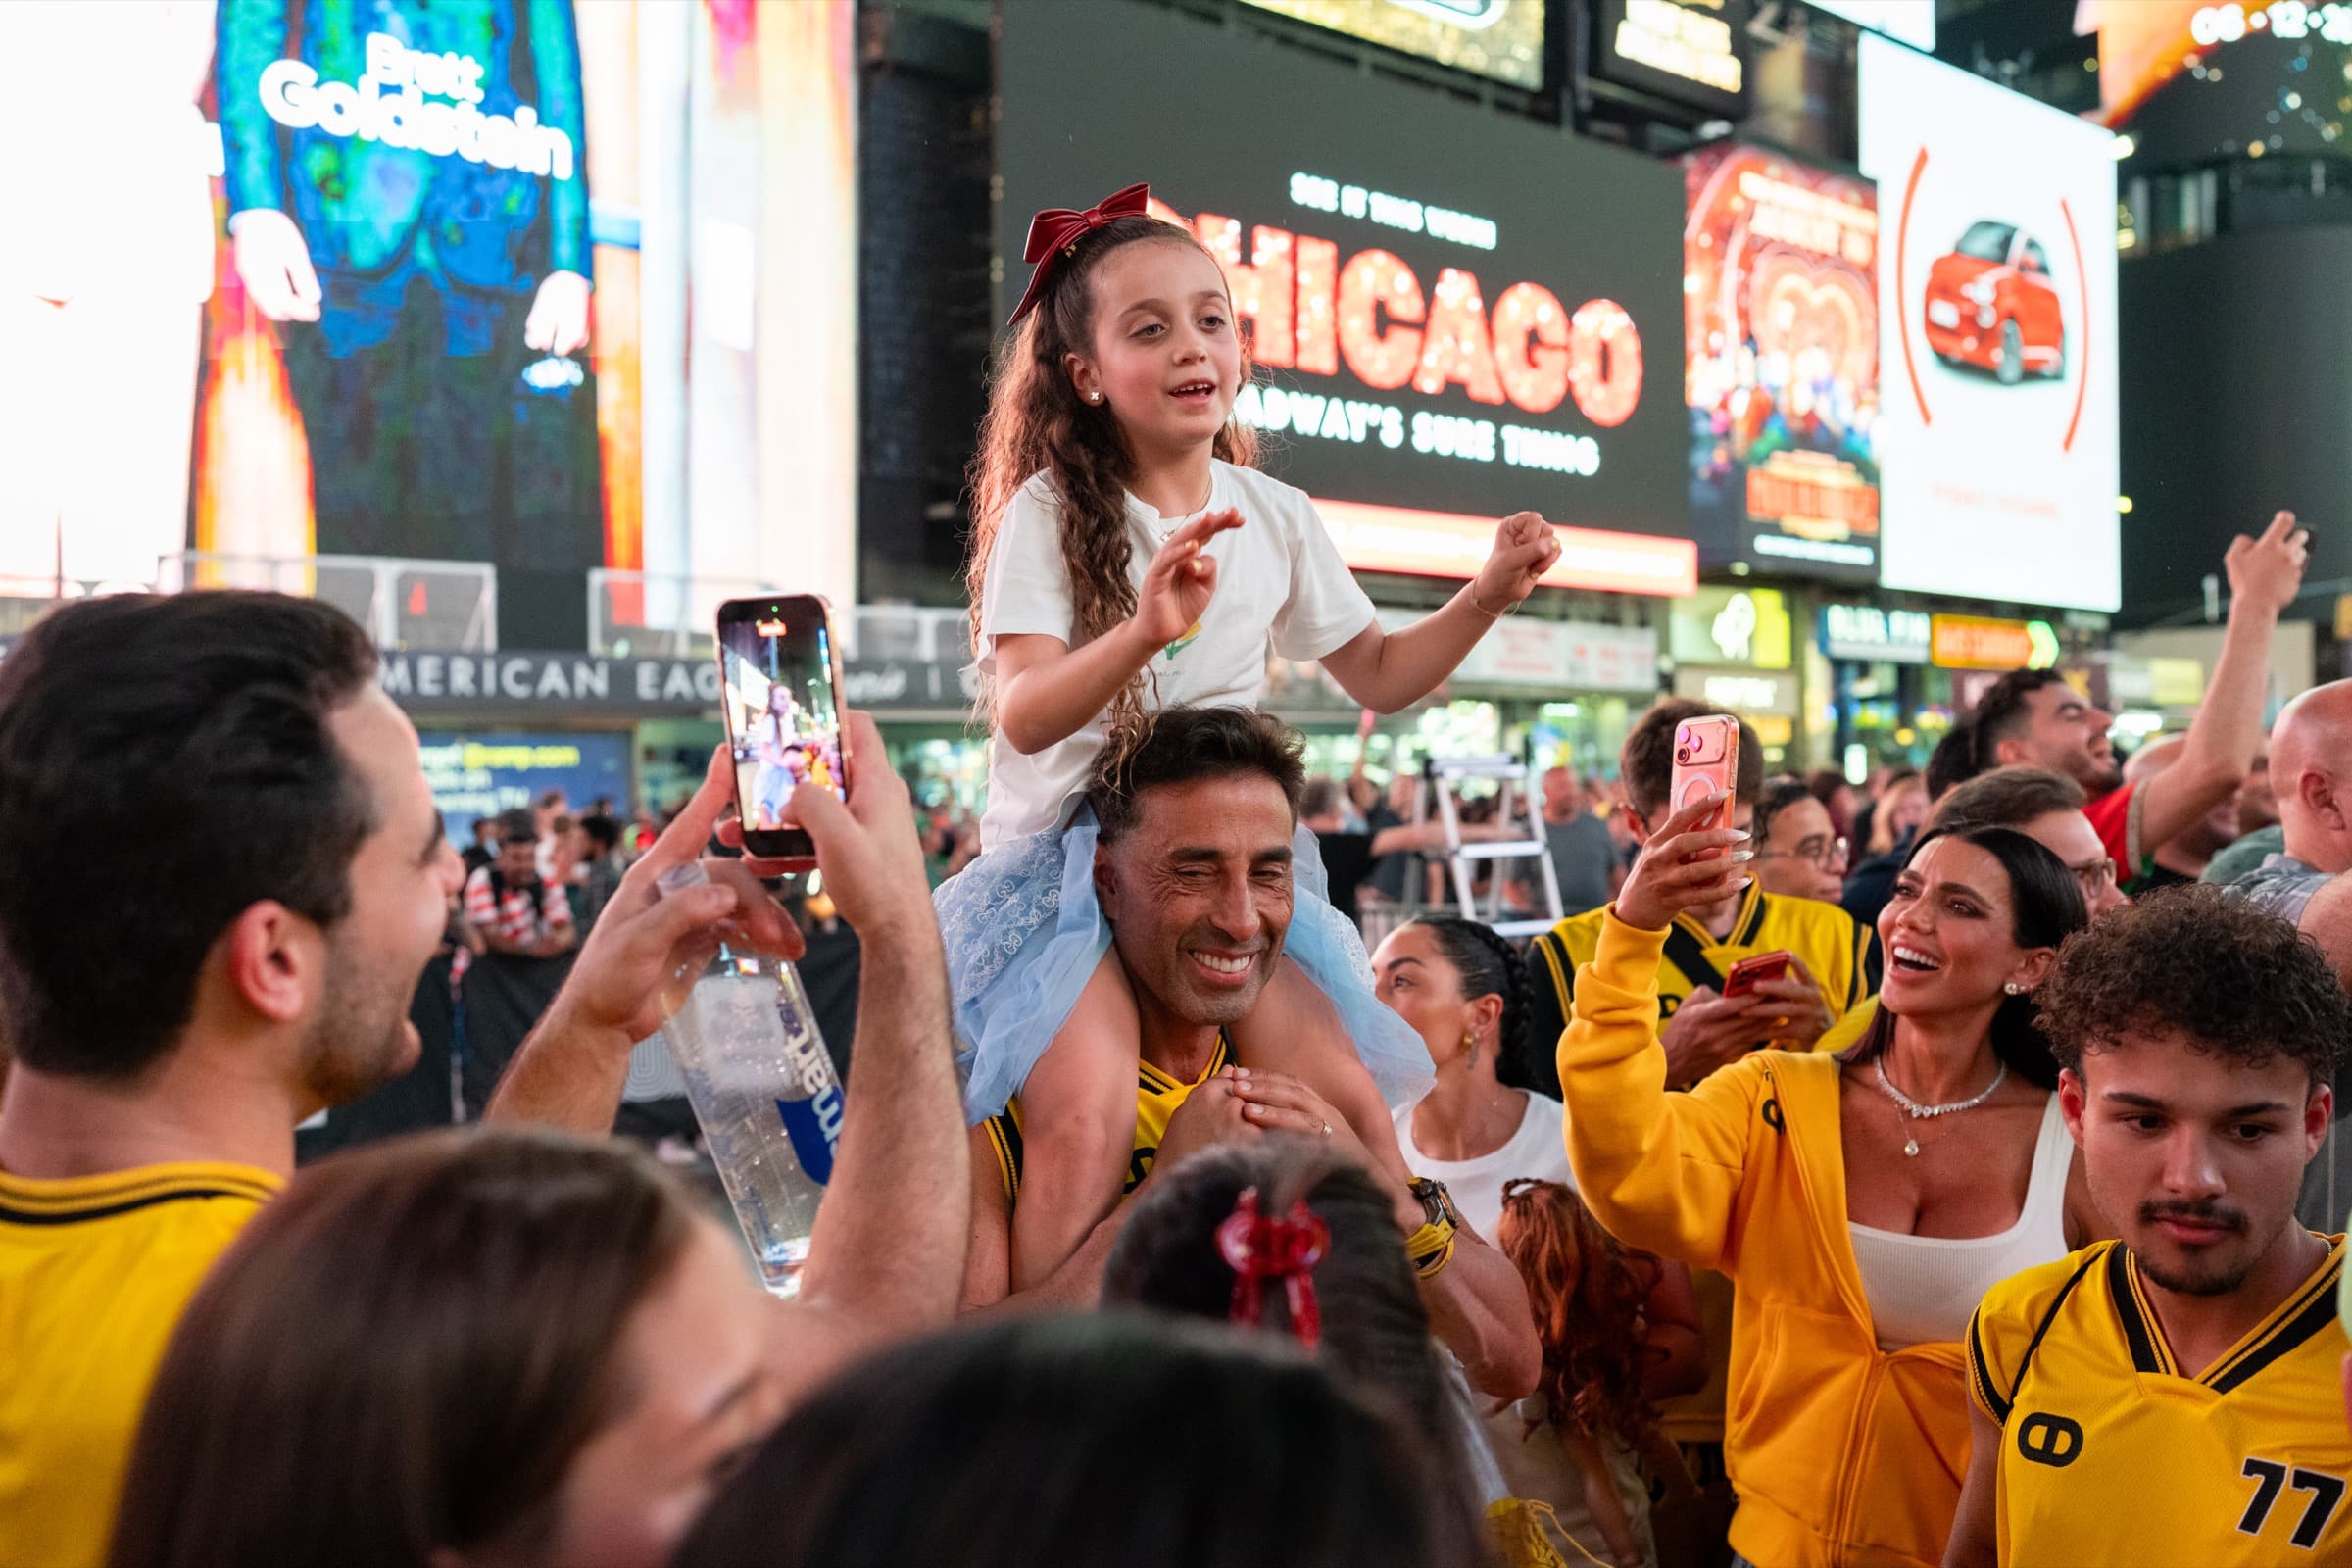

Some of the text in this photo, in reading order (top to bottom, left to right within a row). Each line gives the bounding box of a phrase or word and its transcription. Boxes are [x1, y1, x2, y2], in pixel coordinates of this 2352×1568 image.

[366, 32, 484, 104] Brett
[259, 59, 573, 181] Goldstein
[1149, 199, 1643, 427] HICAGO
[1232, 383, 1600, 477] ADWAY'S SURE THING
[379, 655, 721, 701] MERICAN EAG
[2236, 1456, 2345, 1550] 77
